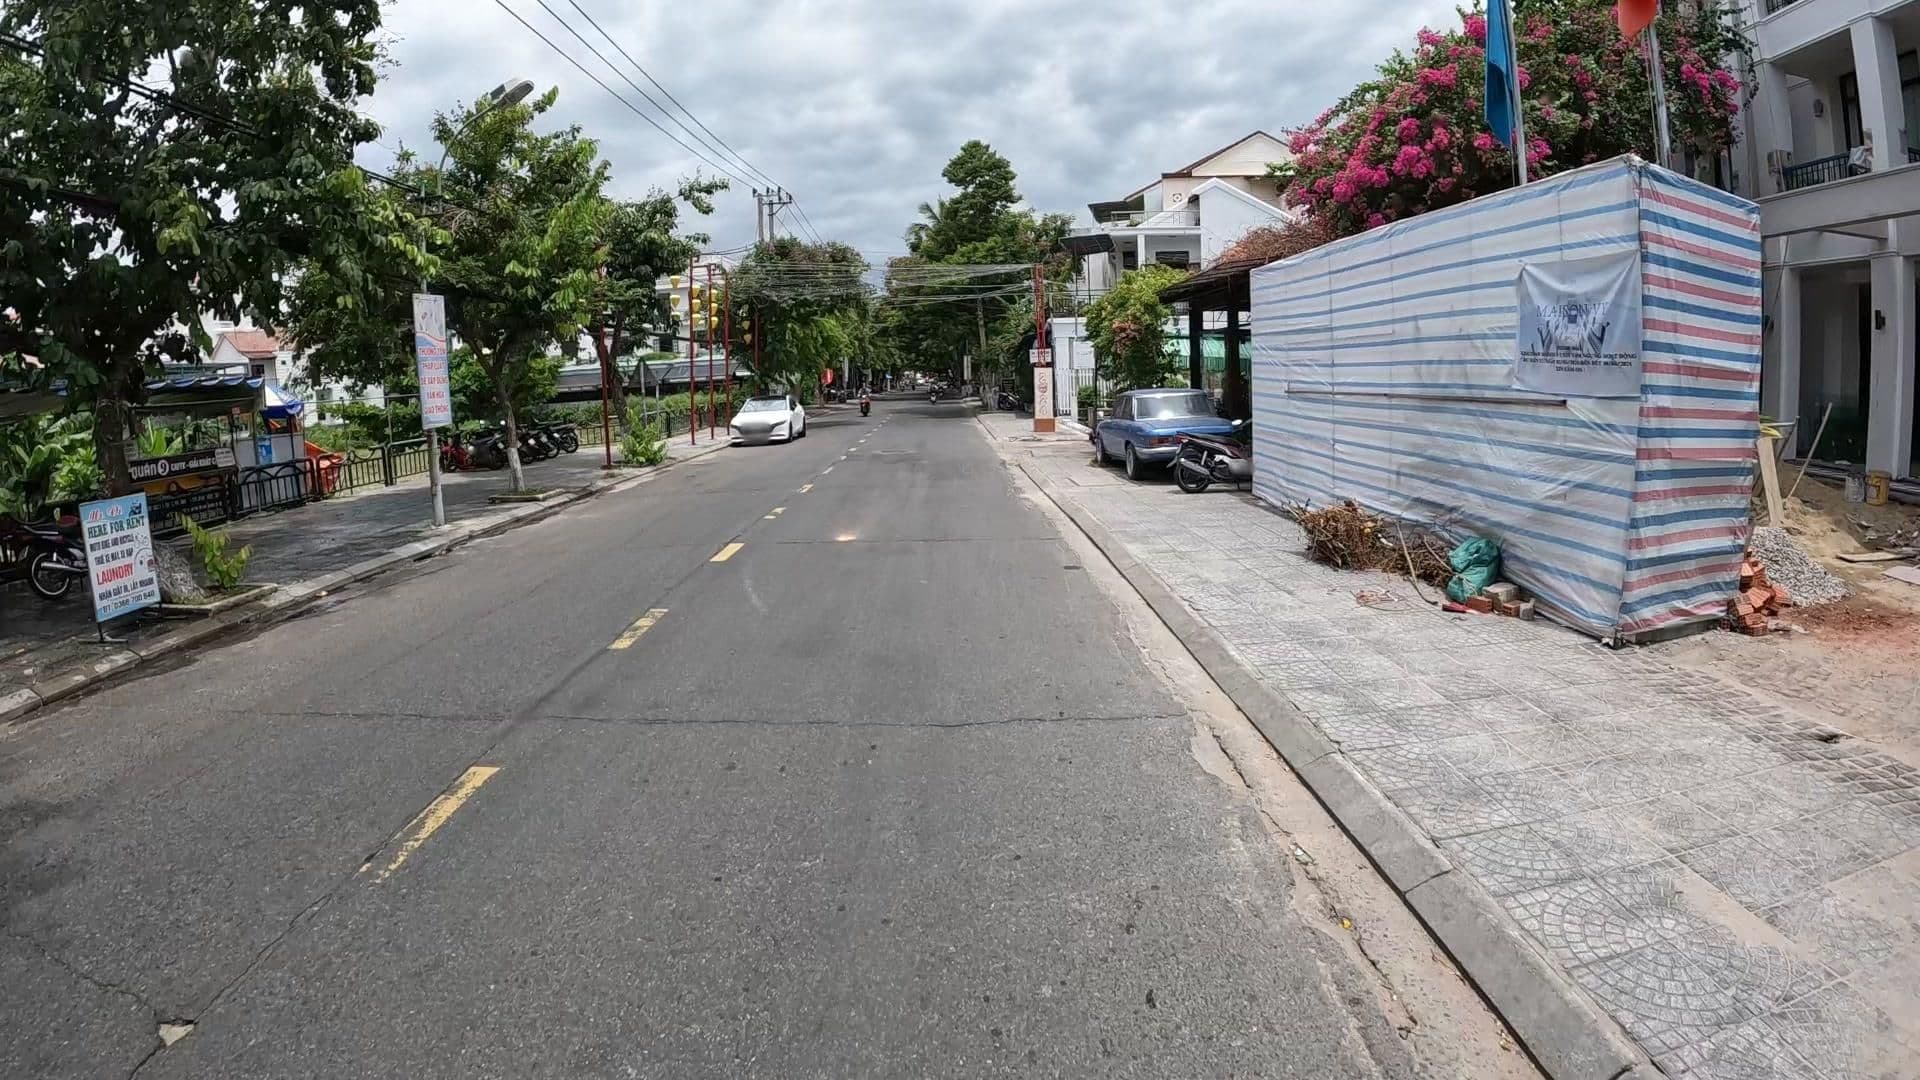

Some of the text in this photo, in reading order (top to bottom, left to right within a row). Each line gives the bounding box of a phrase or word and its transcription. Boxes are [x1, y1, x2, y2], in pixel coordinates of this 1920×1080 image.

[87, 515, 145, 539] HERE FOR RENT
[96, 563, 134, 585] LAUNDRY
